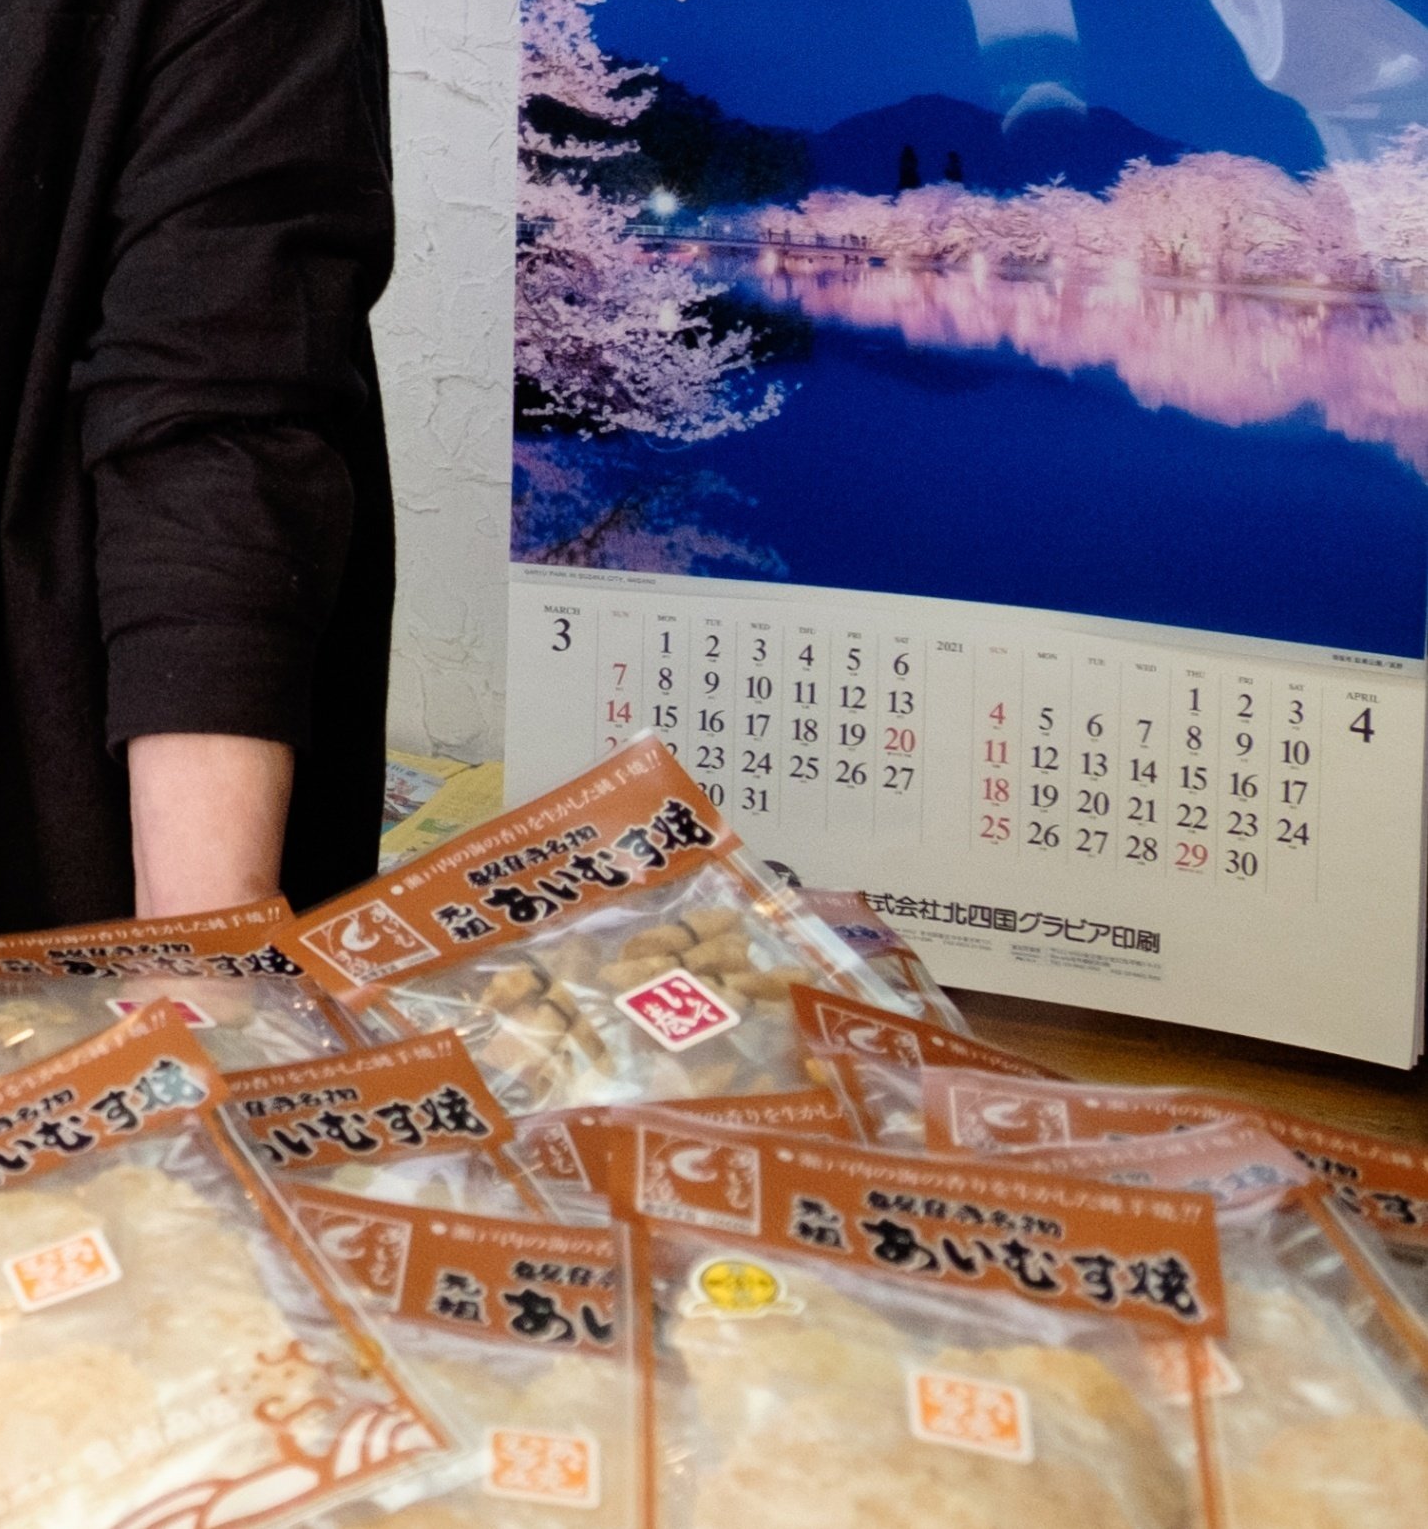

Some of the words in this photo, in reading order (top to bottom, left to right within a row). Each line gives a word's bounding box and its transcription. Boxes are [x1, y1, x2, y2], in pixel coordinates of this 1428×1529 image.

[544, 605, 580, 616] MARCH
[552, 618, 571, 652] 3
[660, 631, 672, 654] 1
[705, 634, 721, 658] 2
[752, 638, 767, 662] 3
[798, 644, 815, 667] 4
[846, 648, 861, 671] 5
[893, 652, 910, 676] 6
[936, 641, 964, 654] 2021
[612, 663, 628, 686] 7
[658, 667, 673, 691] 8
[704, 671, 720, 694] 9
[746, 676, 773, 700] 10
[793, 681, 817, 704] 11
[839, 685, 866, 709] 12
[888, 690, 914, 714] 13
[1188, 688, 1201, 713] 1
[1237, 694, 1254, 718] 2
[1289, 700, 1304, 725] 3
[1346, 692, 1380, 704] APRIL
[605, 700, 633, 723] 14
[652, 704, 678, 728] 15
[697, 709, 725, 733] 16
[746, 713, 771, 737] 17
[791, 718, 818, 742] 18
[839, 723, 866, 747] 19
[884, 727, 917, 752] 20
[989, 702, 1006, 725] 4
[1038, 707, 1054, 731] 5
[1086, 714, 1103, 738] 6
[1137, 720, 1153, 744] 7
[1187, 725, 1202, 750] 8
[1236, 732, 1253, 757] 9
[1280, 739, 1309, 765] 10
[1349, 708, 1375, 743] 4
[697, 746, 725, 769] 23
[742, 750, 773, 774] 24
[789, 755, 820, 779] 25
[835, 760, 867, 785] 26
[883, 765, 915, 790] 27
[984, 739, 1009, 765] 11
[1031, 746, 1059, 771] 12
[1081, 752, 1108, 777] 13
[1130, 758, 1158, 783] 14
[1180, 765, 1207, 791] 15
[1229, 772, 1257, 798] 16
[1280, 780, 1308, 805] 17
[742, 787, 770, 812] 31
[982, 777, 1010, 802] 18
[1030, 783, 1059, 809] 19
[1077, 790, 1110, 816] 20
[1128, 797, 1157, 823] 21
[1177, 804, 1209, 830] 22
[1227, 811, 1259, 837] 23
[1277, 819, 1309, 846] 24
[485, 797, 715, 924] あいむす焼
[981, 816, 1011, 841] 25
[1027, 822, 1060, 848] 26
[1077, 828, 1109, 855] 27
[1126, 835, 1158, 861] 28
[1175, 842, 1209, 868] 29
[1226, 850, 1258, 877] 30
[861, 1218, 1200, 1318] あいむす焼
